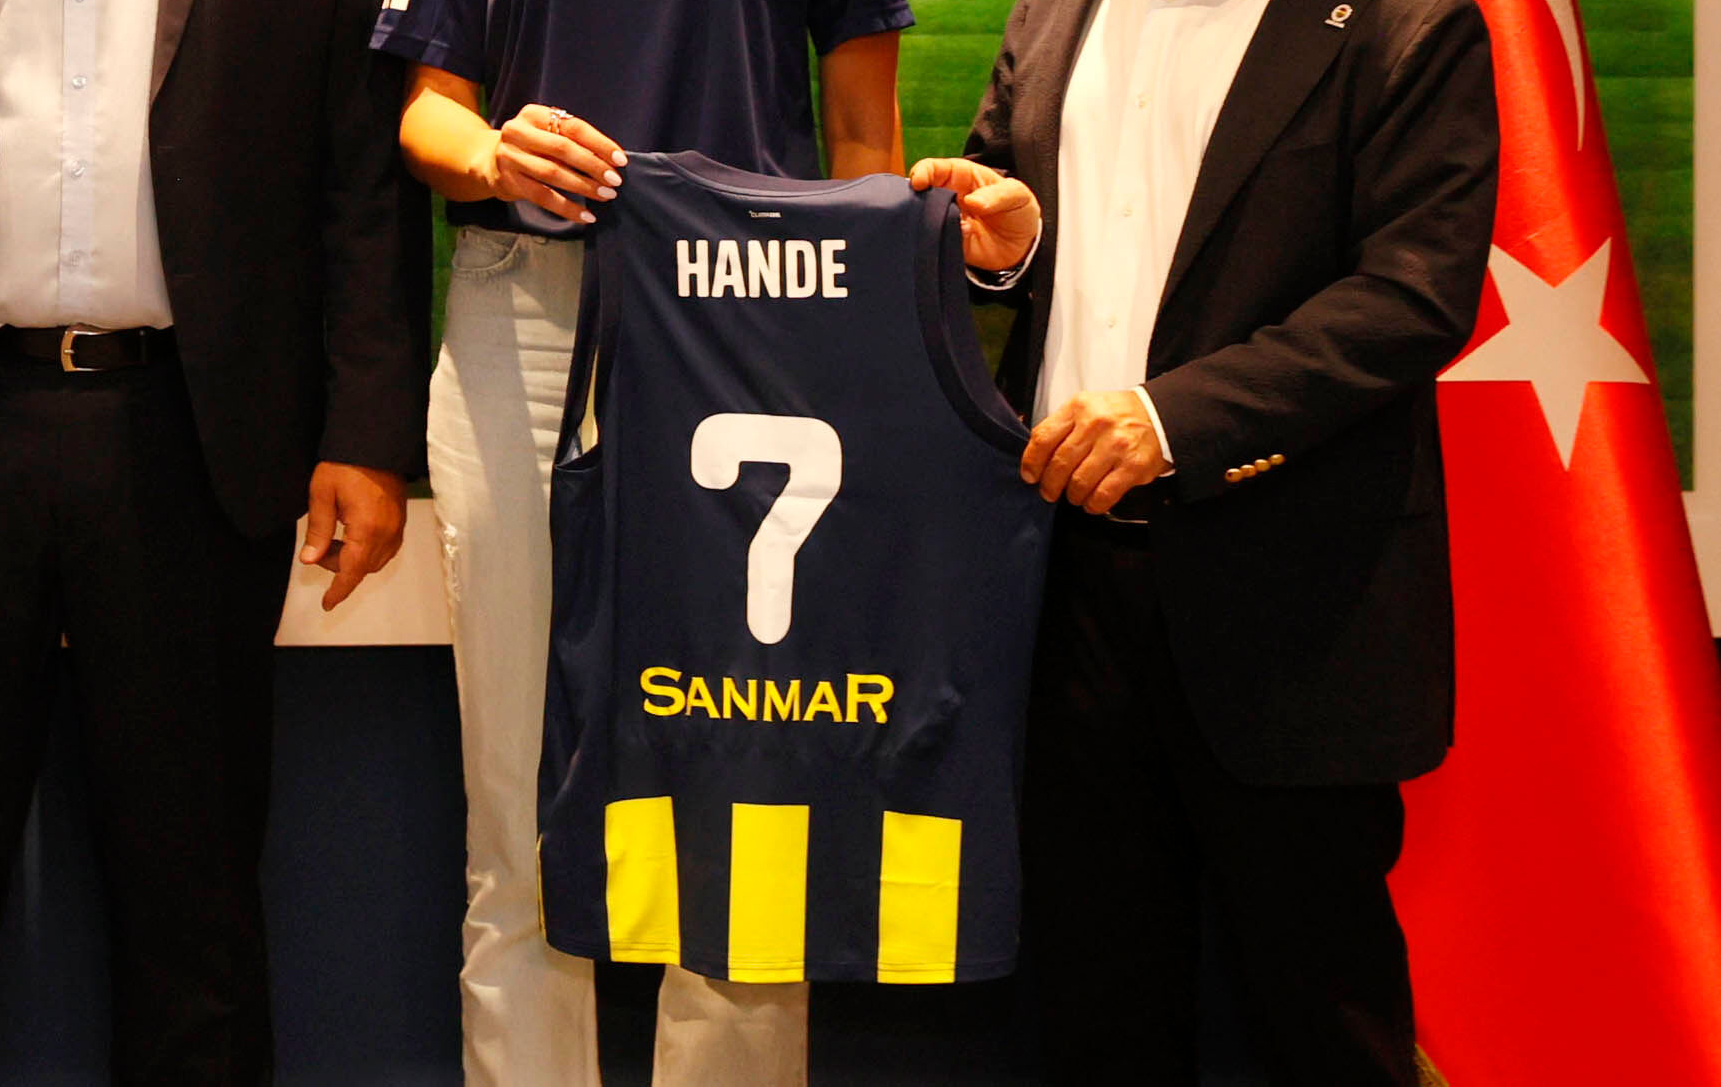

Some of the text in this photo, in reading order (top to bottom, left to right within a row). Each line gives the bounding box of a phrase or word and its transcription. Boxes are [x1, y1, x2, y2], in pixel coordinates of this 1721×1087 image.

[676, 239, 848, 298] HANDE
[691, 413, 842, 644] 7
[640, 666, 894, 724] SANMAR
